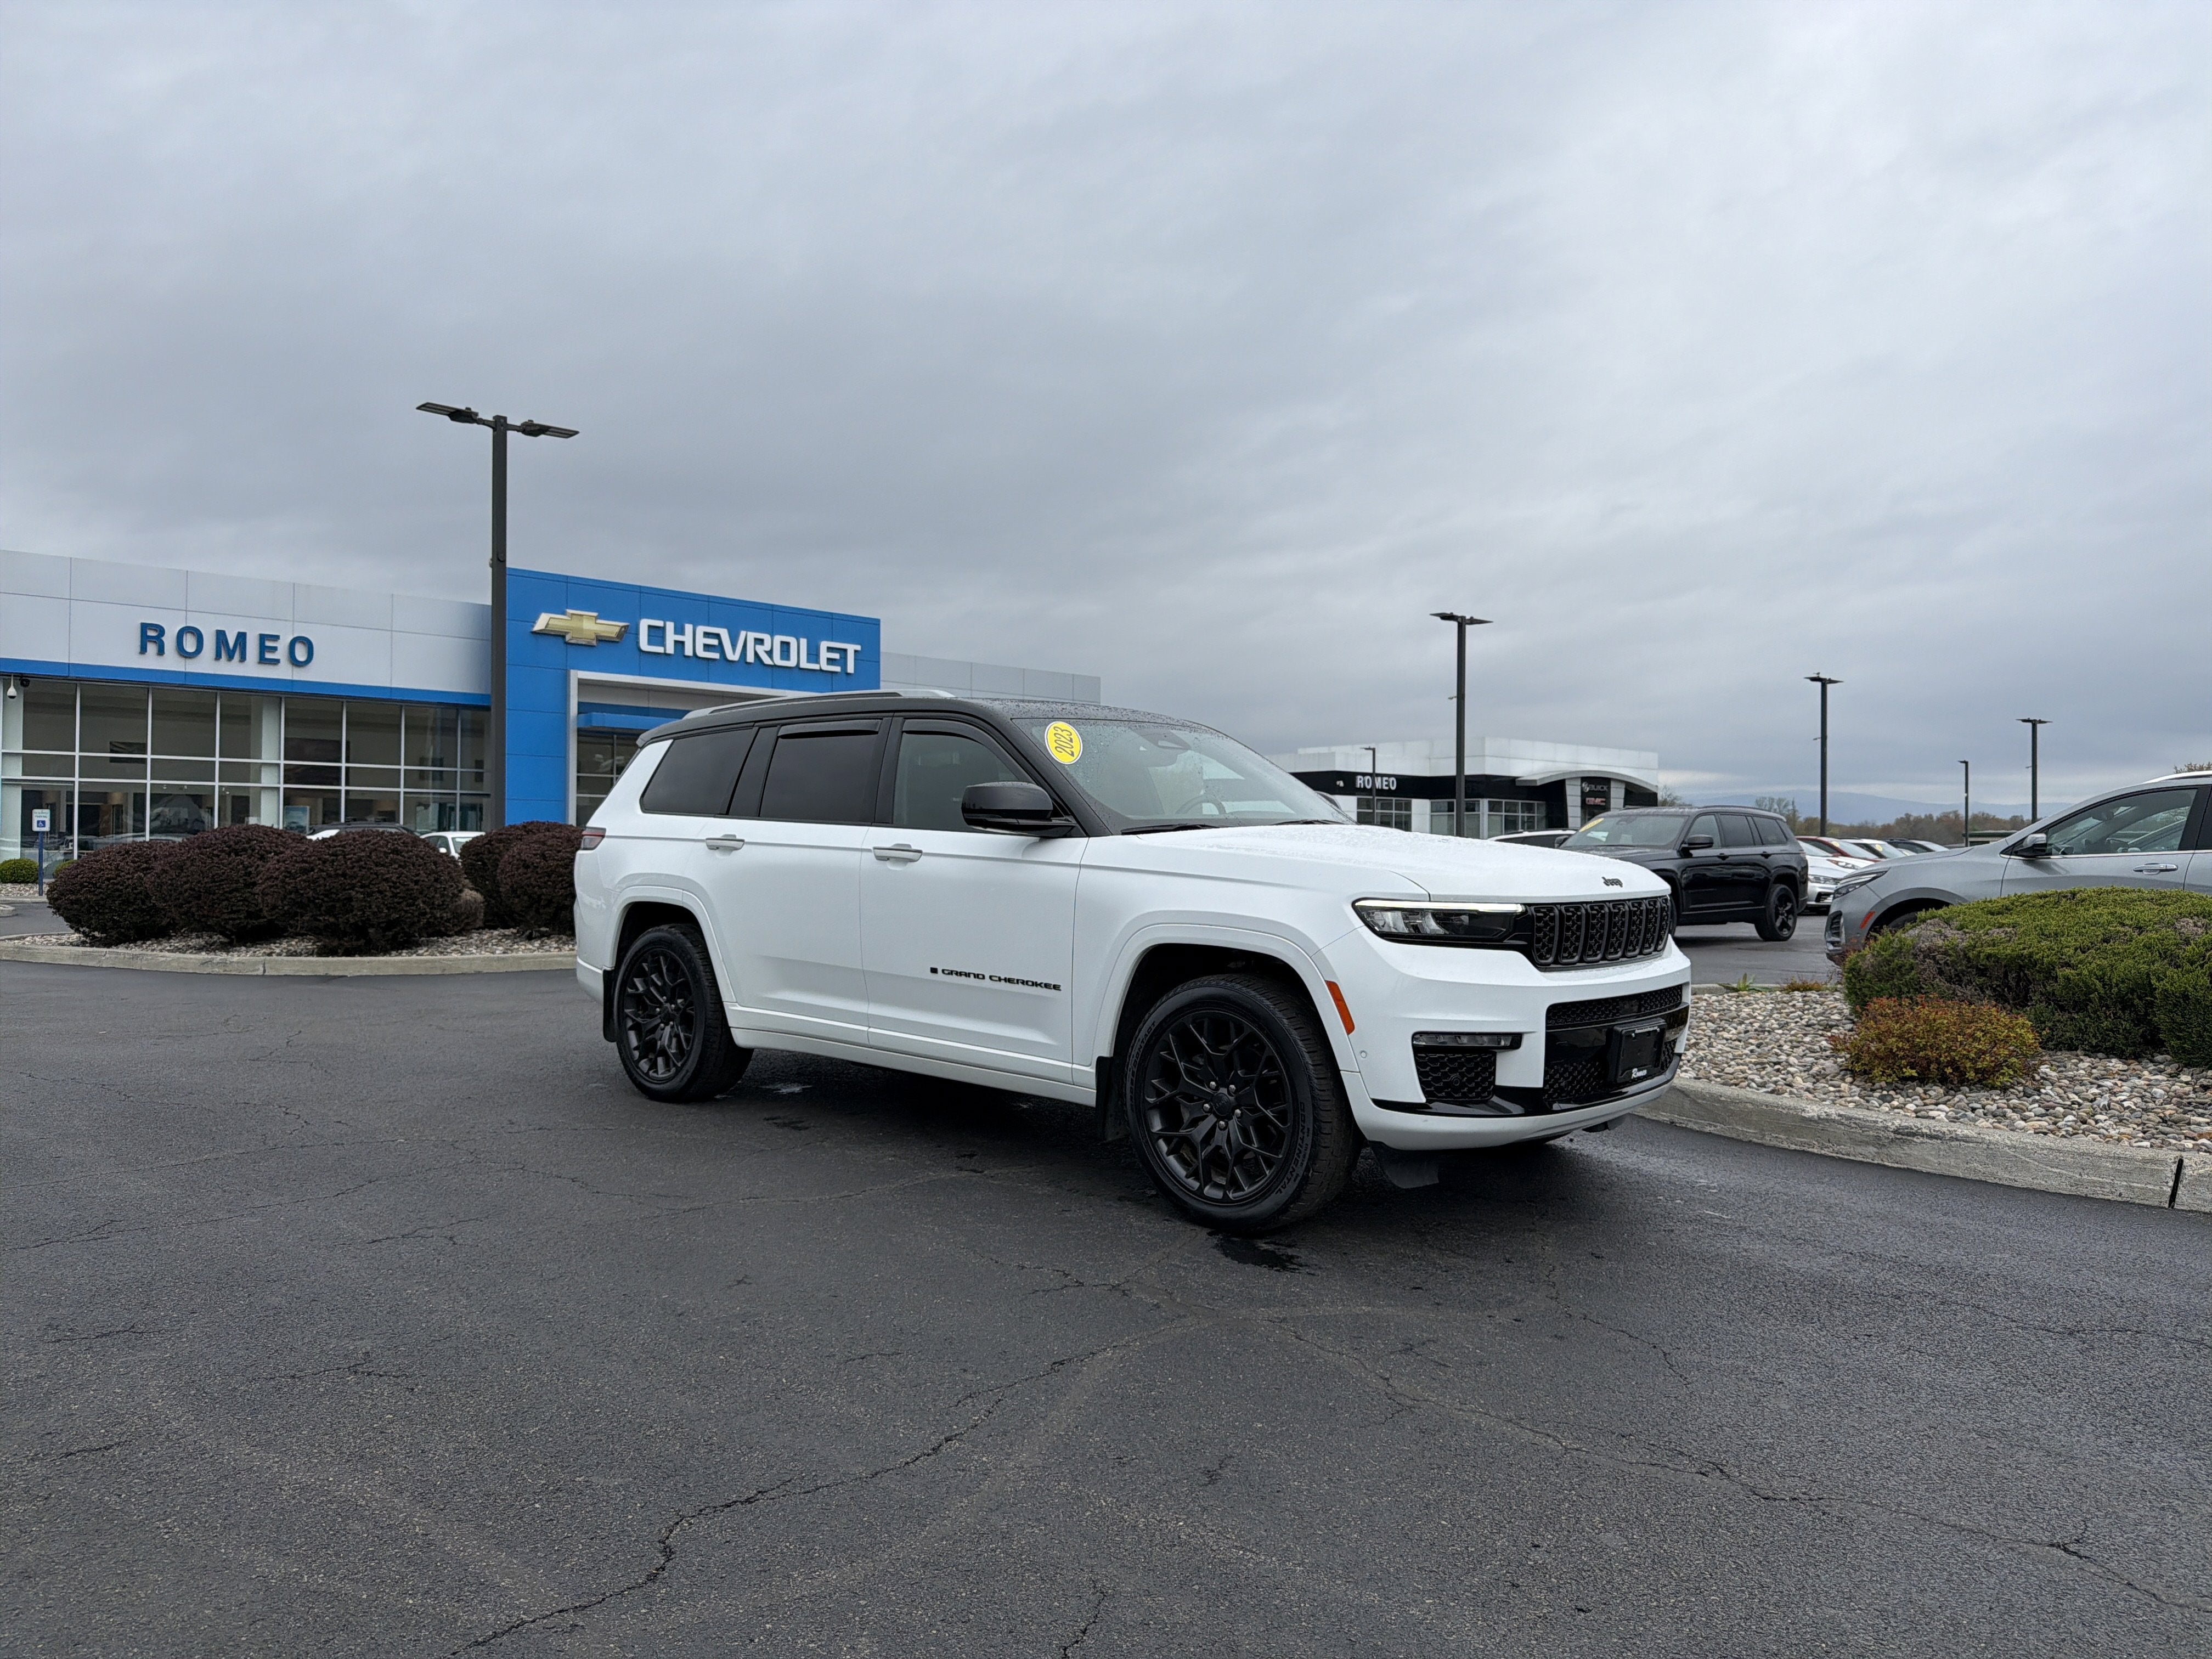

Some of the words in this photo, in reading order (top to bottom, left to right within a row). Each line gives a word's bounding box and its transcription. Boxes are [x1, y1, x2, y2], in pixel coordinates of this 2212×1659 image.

[139, 622, 314, 667] ROMEO
[639, 618, 861, 674] CHEVROLET
[1053, 726, 1074, 757] 2023
[1356, 775, 1397, 790] ROMEO
[1601, 876, 1623, 888] Jeep
[941, 969, 985, 980] GRAND
[989, 975, 1062, 991] CHEROKEE
[1275, 1101, 1305, 1195] CONTINENTAL
